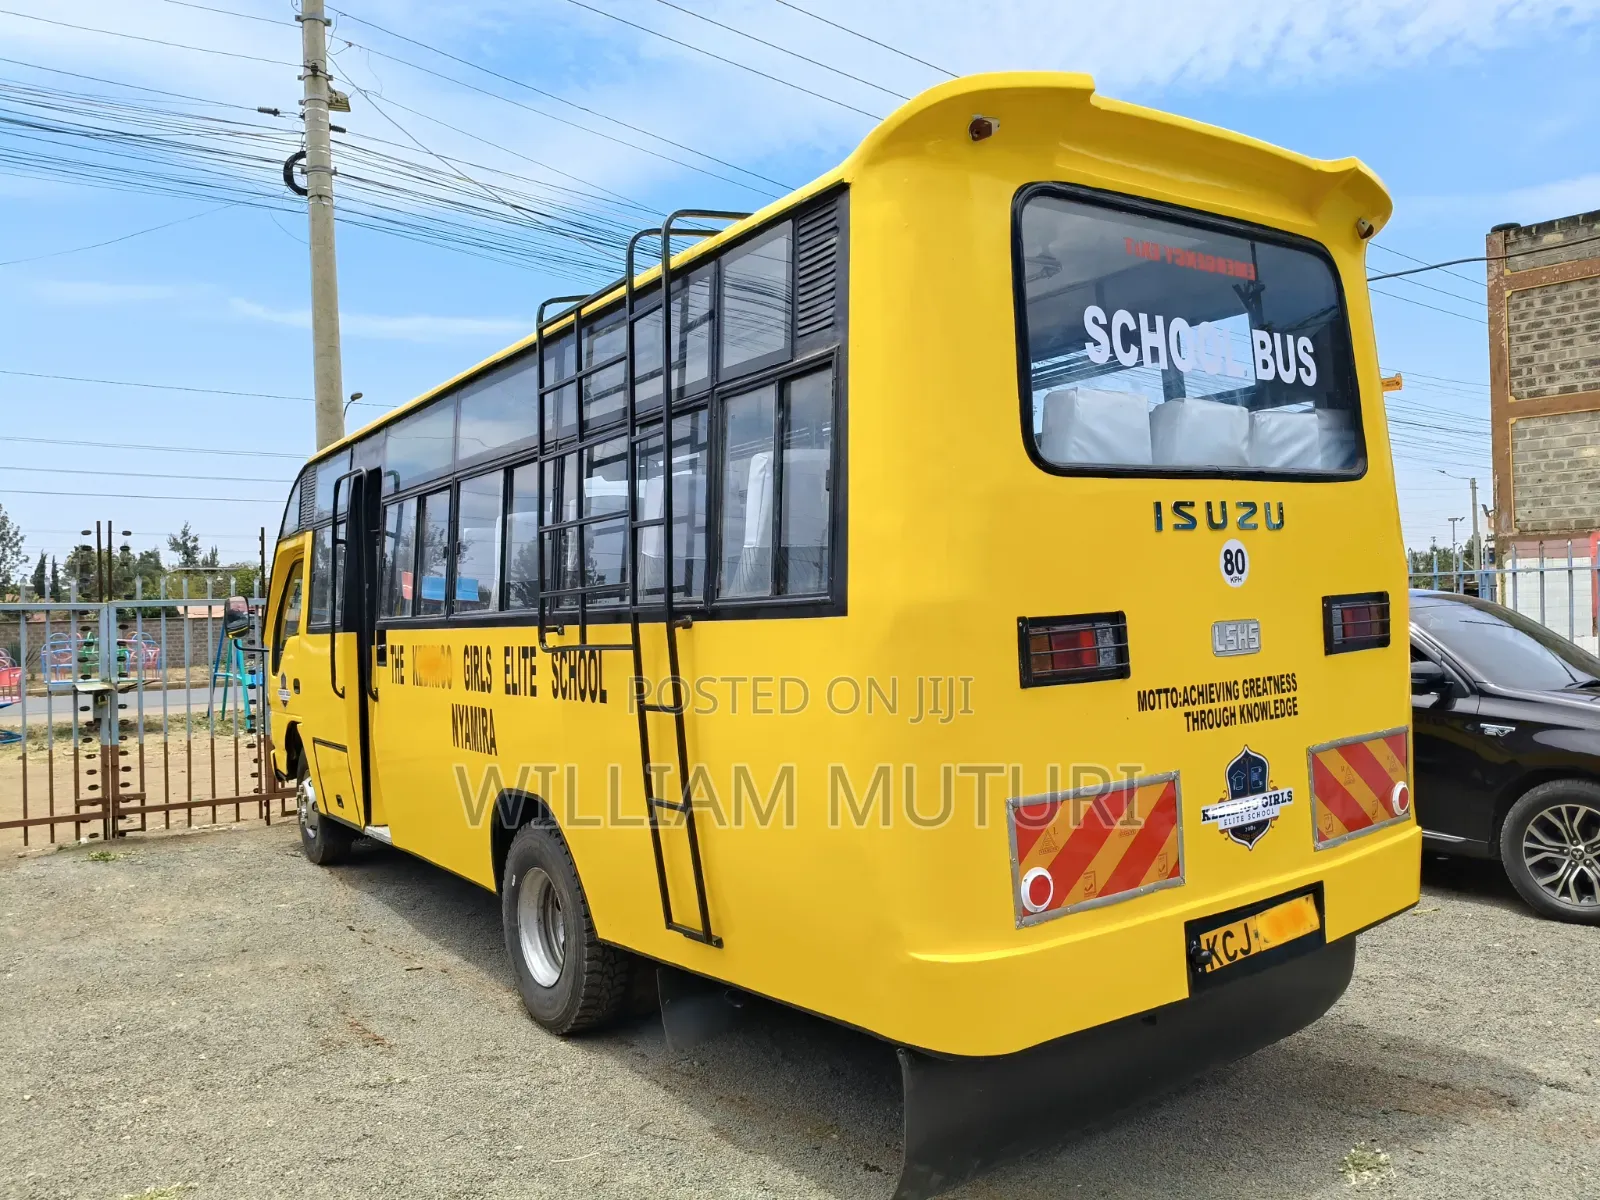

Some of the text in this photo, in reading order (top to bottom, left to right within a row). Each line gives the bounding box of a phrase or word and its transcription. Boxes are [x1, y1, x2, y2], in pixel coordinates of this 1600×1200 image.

[1083, 305, 1317, 387] SCHOOL BUS
[1153, 501, 1285, 532] ISUZU
[1223, 548, 1246, 576] 80
[1230, 575, 1242, 583] KPH
[390, 644, 404, 685] THE
[463, 644, 493, 694] GIRLS
[504, 646, 537, 697] ELITE
[551, 645, 608, 704] SCHOOL
[1242, 672, 1298, 699] GREATNESS
[451, 703, 498, 756] NYAMIRA
[1184, 696, 1298, 732] THROUGH KNOWLEDGE
[1261, 790, 1293, 808] GIRLS
[1223, 815, 1245, 826] ELITE
[1247, 808, 1275, 820] SCHOOL
[1205, 922, 1251, 970] KCJ
